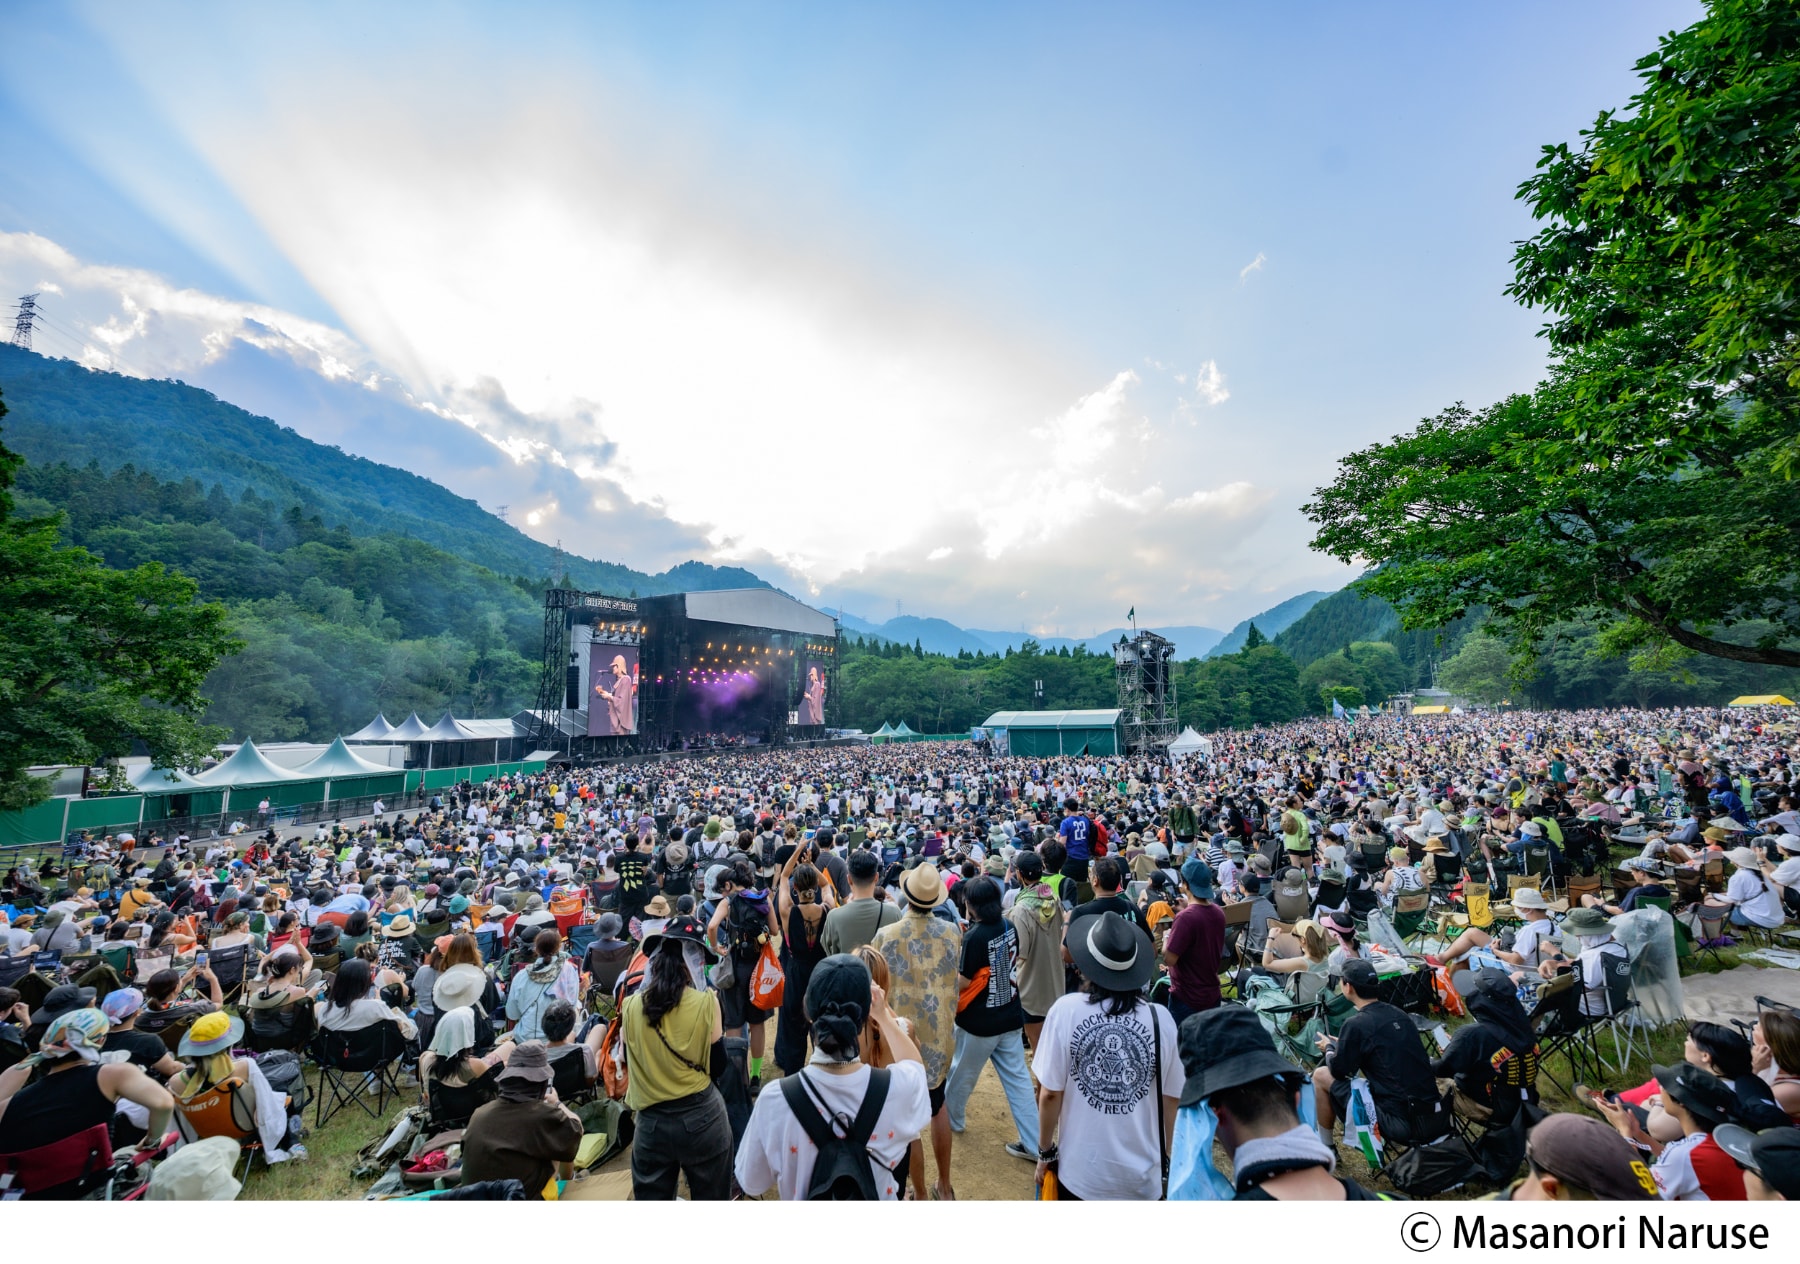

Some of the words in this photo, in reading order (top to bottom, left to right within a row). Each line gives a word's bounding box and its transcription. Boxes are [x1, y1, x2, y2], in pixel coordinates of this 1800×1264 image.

[585, 597, 611, 608] GREEN
[612, 601, 637, 611] STAGE
[1072, 820, 1087, 841] 22
[988, 976, 997, 993] ROCK
[1076, 1013, 1105, 1035] ROCK
[1106, 1015, 1155, 1050] FESTIVAL
[1073, 1076, 1103, 1112] TOWER
